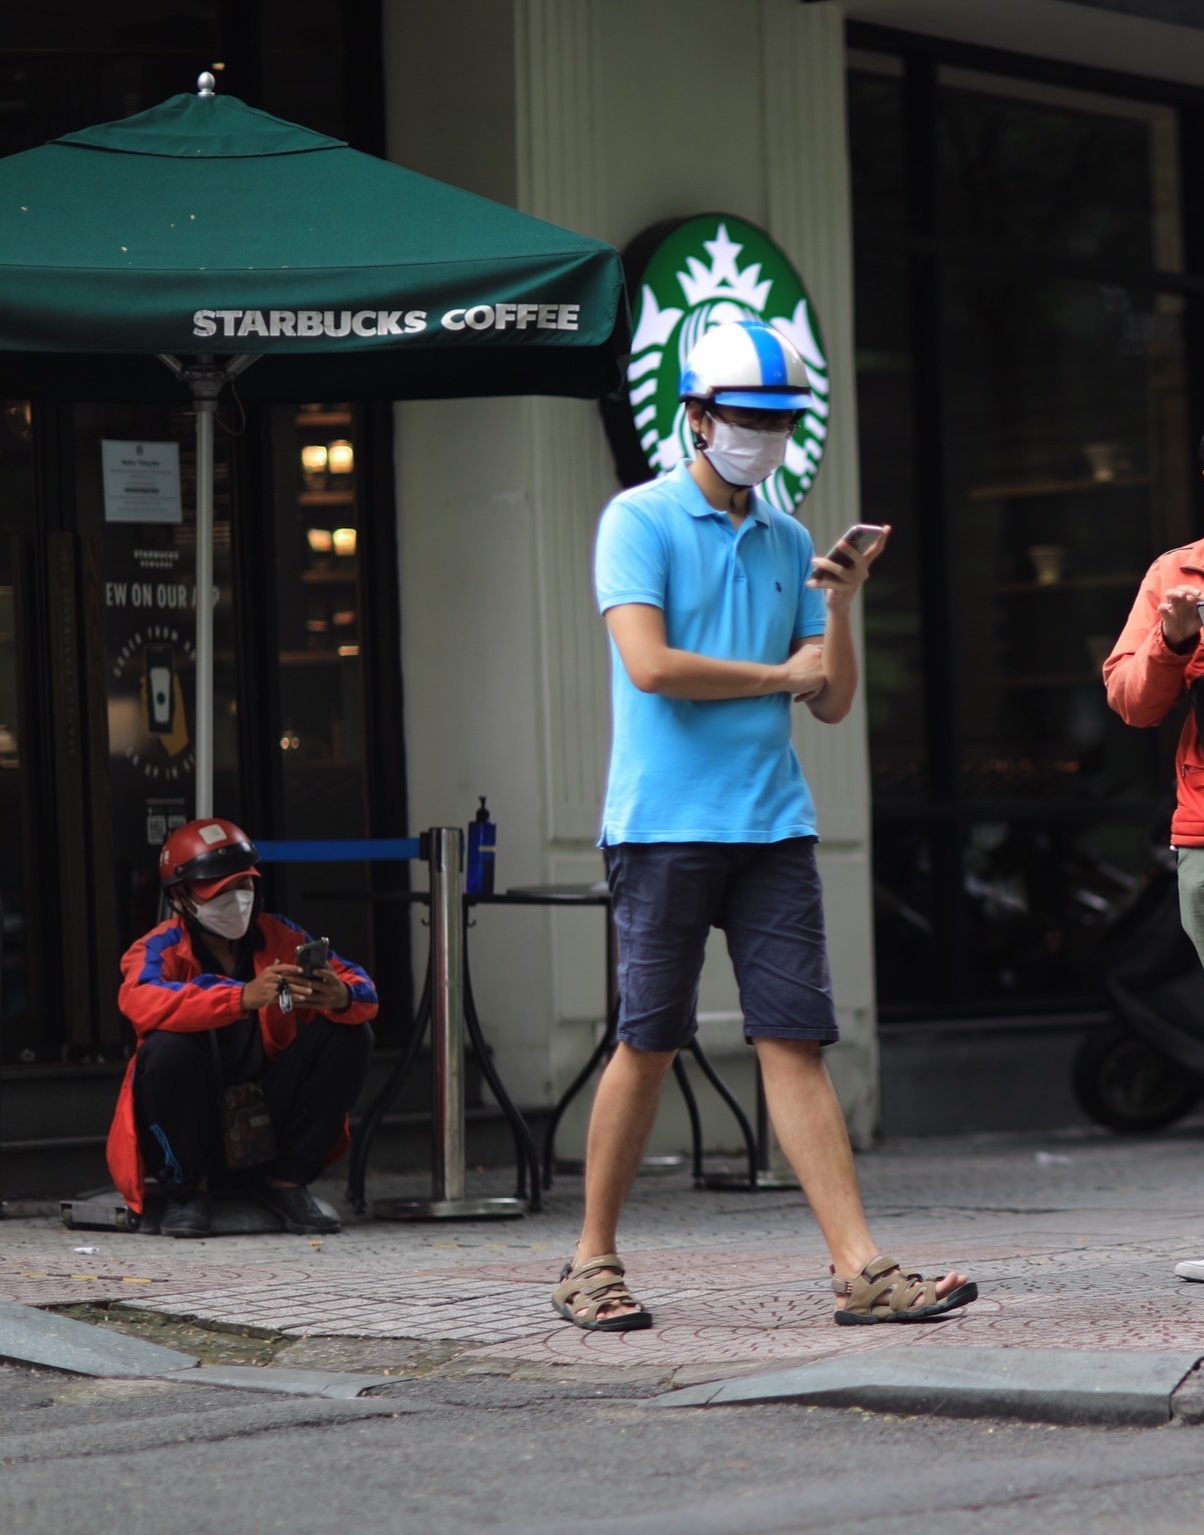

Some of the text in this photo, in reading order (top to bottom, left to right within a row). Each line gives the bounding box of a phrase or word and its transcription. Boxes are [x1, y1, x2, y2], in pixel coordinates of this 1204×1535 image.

[193, 302, 580, 337] STARBUCKS COFFEE
[105, 581, 127, 608] EW
[131, 583, 153, 608] ON
[156, 583, 187, 609] OUR
